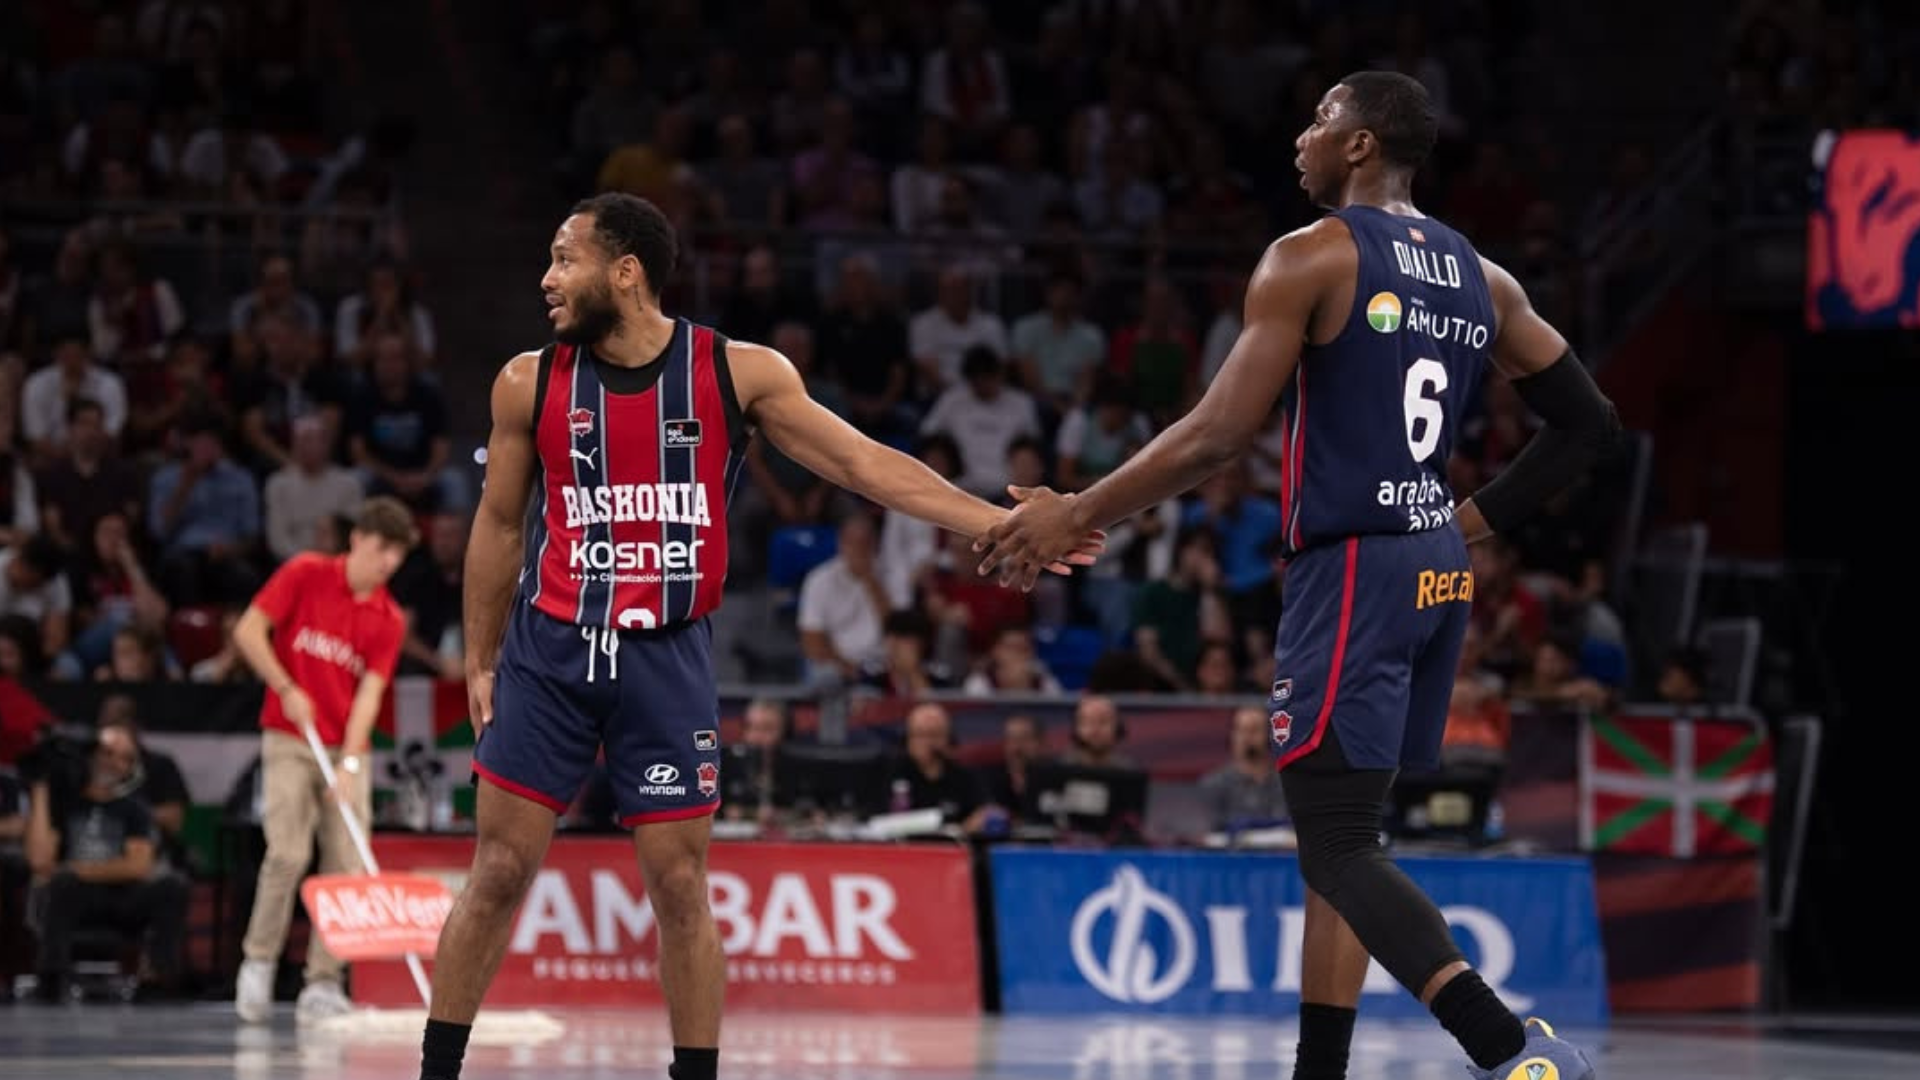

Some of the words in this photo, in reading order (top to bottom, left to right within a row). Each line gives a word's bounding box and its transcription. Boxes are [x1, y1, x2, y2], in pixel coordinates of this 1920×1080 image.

[1393, 240, 1461, 288] DIALLO
[1407, 307, 1488, 349] AMUTIO
[1404, 357, 1448, 463] 6
[562, 482, 711, 529] BASKONIA
[569, 539, 705, 570] kosner
[1416, 570, 1474, 609] Reca
[639, 785, 686, 796] HYUNDAI
[509, 869, 915, 960] AMBAR
[727, 959, 896, 985] ERVECEROS
